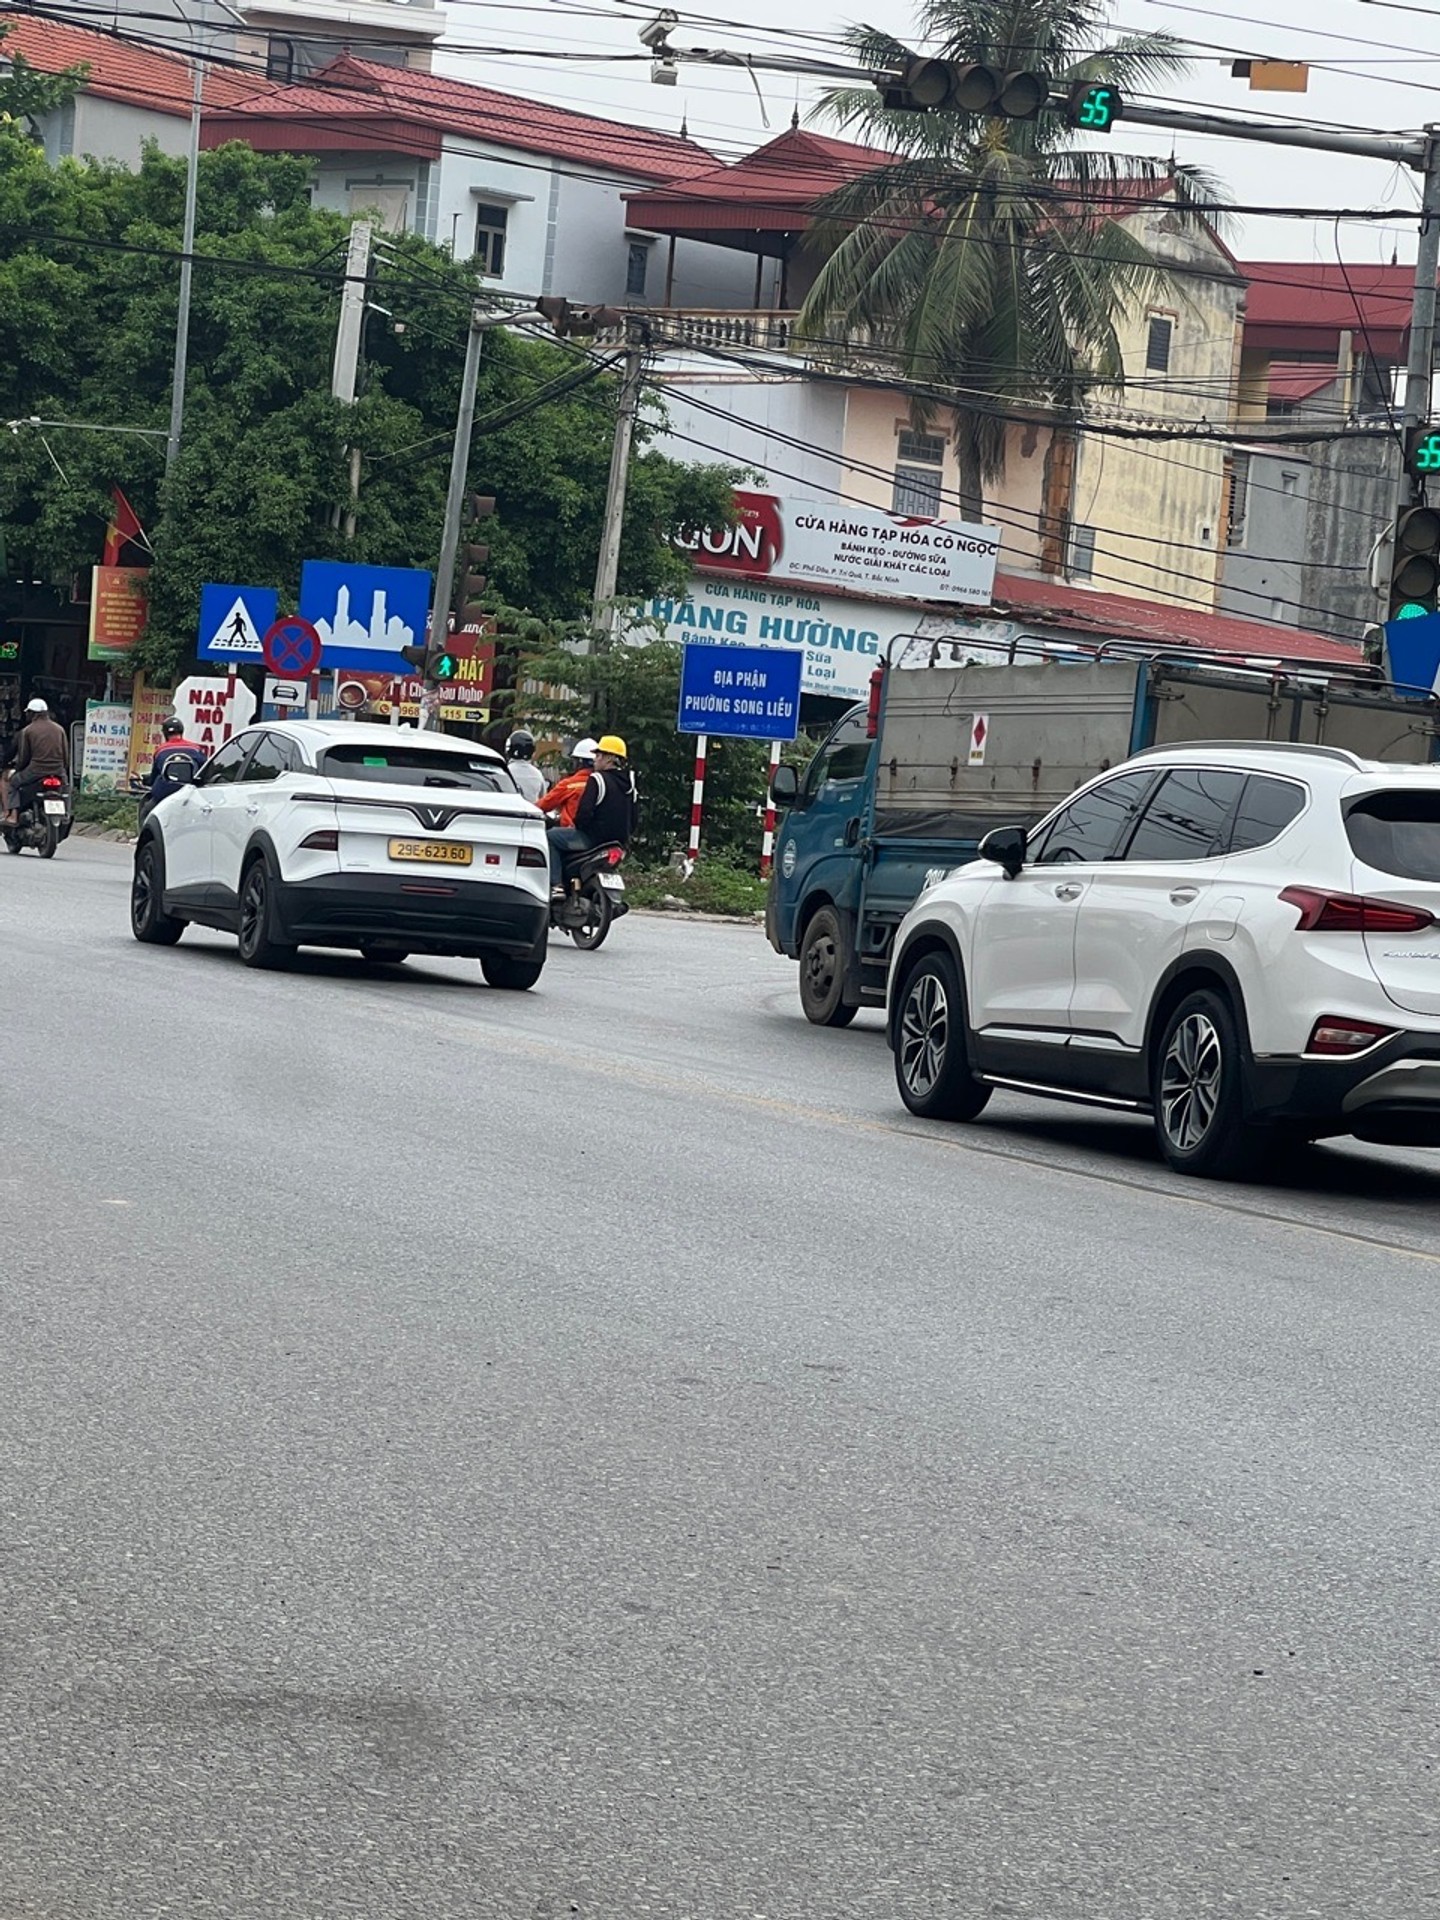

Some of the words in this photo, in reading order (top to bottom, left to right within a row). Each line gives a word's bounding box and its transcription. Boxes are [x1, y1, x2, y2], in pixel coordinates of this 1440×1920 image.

[795, 514, 825, 531] CỬA
[829, 519, 868, 537] HÀNG
[872, 528, 898, 543] TẠP
[900, 530, 929, 546] HÓA
[933, 535, 954, 549] CÔ
[957, 540, 997, 558] NGỌC
[841, 542, 866, 553] BÁNH
[928, 553, 947, 565] SỮA
[834, 553, 862, 566] NƯỚC
[883, 560, 907, 572] KHÁT
[908, 564, 927, 575] CÁC
[928, 567, 951, 579] LOẠI
[705, 582, 730, 598] CỬA
[770, 593, 793, 608] TẠP
[636, 595, 748, 635] HẮNG
[759, 614, 879, 655] HƯỜNG
[714, 670, 733, 688] ĐỊA
[736, 669, 767, 690] PHẬN
[807, 665, 836, 680] Loại
[685, 693, 731, 713] PHƯỜNG
[733, 698, 763, 715] SONG
[195, 707, 223, 725] MÔ
[201, 727, 213, 742] A
